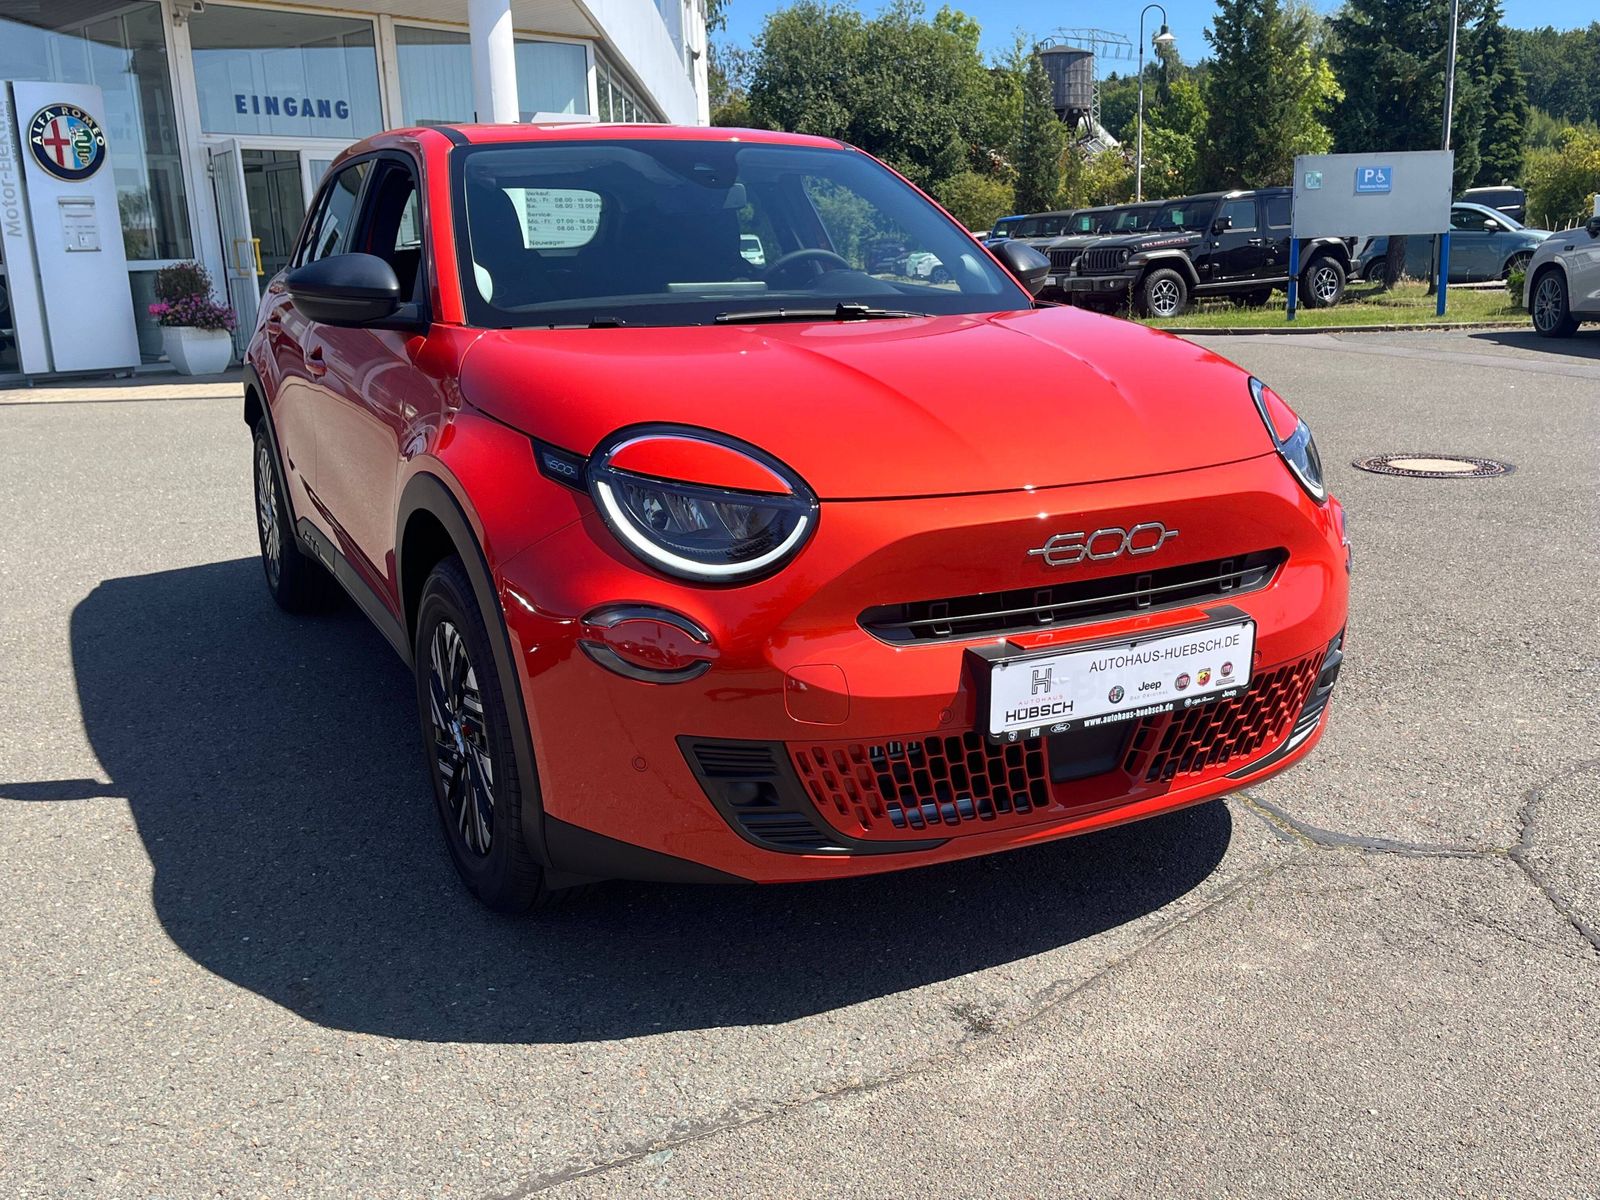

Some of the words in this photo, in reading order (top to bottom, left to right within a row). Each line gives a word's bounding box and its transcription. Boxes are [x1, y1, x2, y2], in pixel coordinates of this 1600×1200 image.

[235, 94, 349, 119] EINGANG
[32, 110, 56, 145] ALFA
[60, 106, 105, 147] ROMEO
[1364, 169, 1375, 183] P
[1027, 522, 1179, 566] 600
[1089, 634, 1240, 673] AUTOHAUS-HUEBSCH.DE
[1138, 681, 1162, 691] Jeep
[1222, 690, 1237, 698] Jeep
[1005, 700, 1074, 722] HÜBSCH
[1019, 694, 1063, 705] AUTOHAUS
[1084, 702, 1174, 728] www.autohaus-huebsch.de
